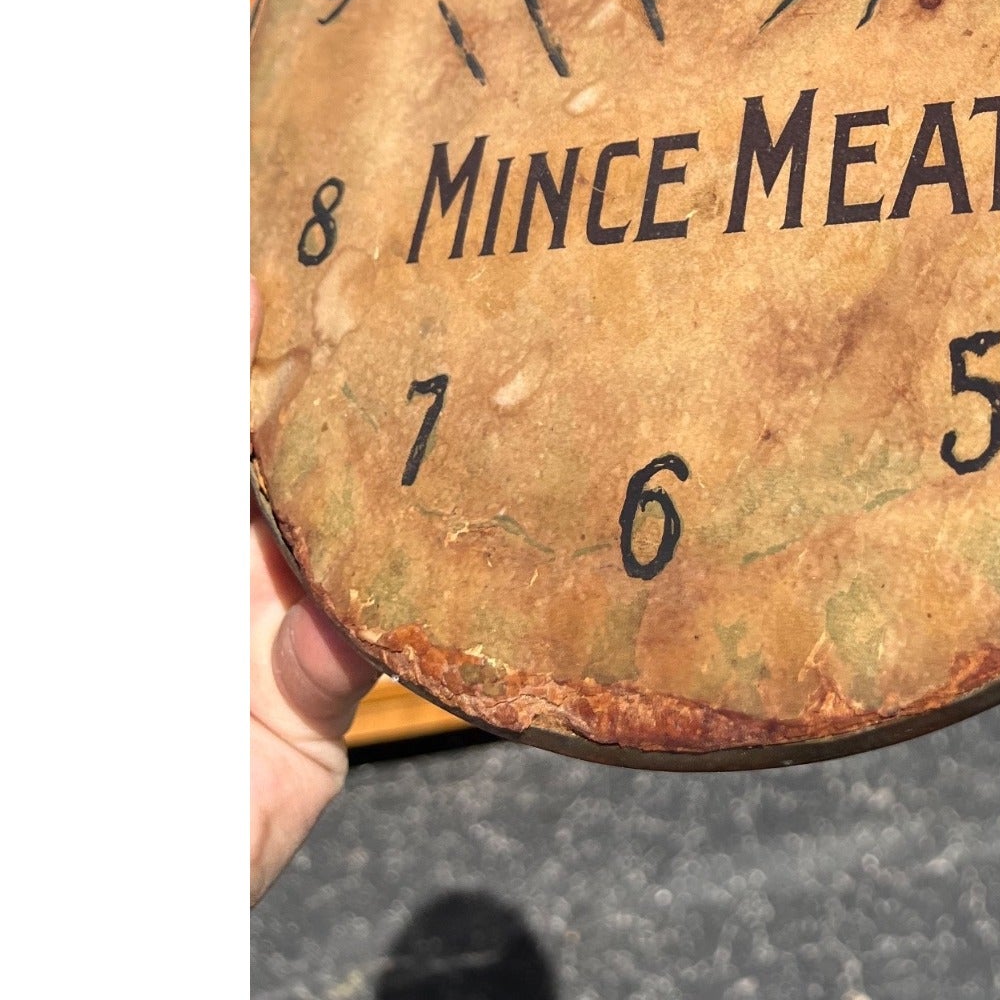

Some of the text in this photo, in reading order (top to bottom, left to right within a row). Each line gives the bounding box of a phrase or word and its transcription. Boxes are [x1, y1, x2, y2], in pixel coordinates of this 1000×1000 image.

[297, 176, 345, 267] 8
[406, 129, 700, 264] MINCE
[401, 373, 449, 487] 7
[618, 454, 691, 581] 6
